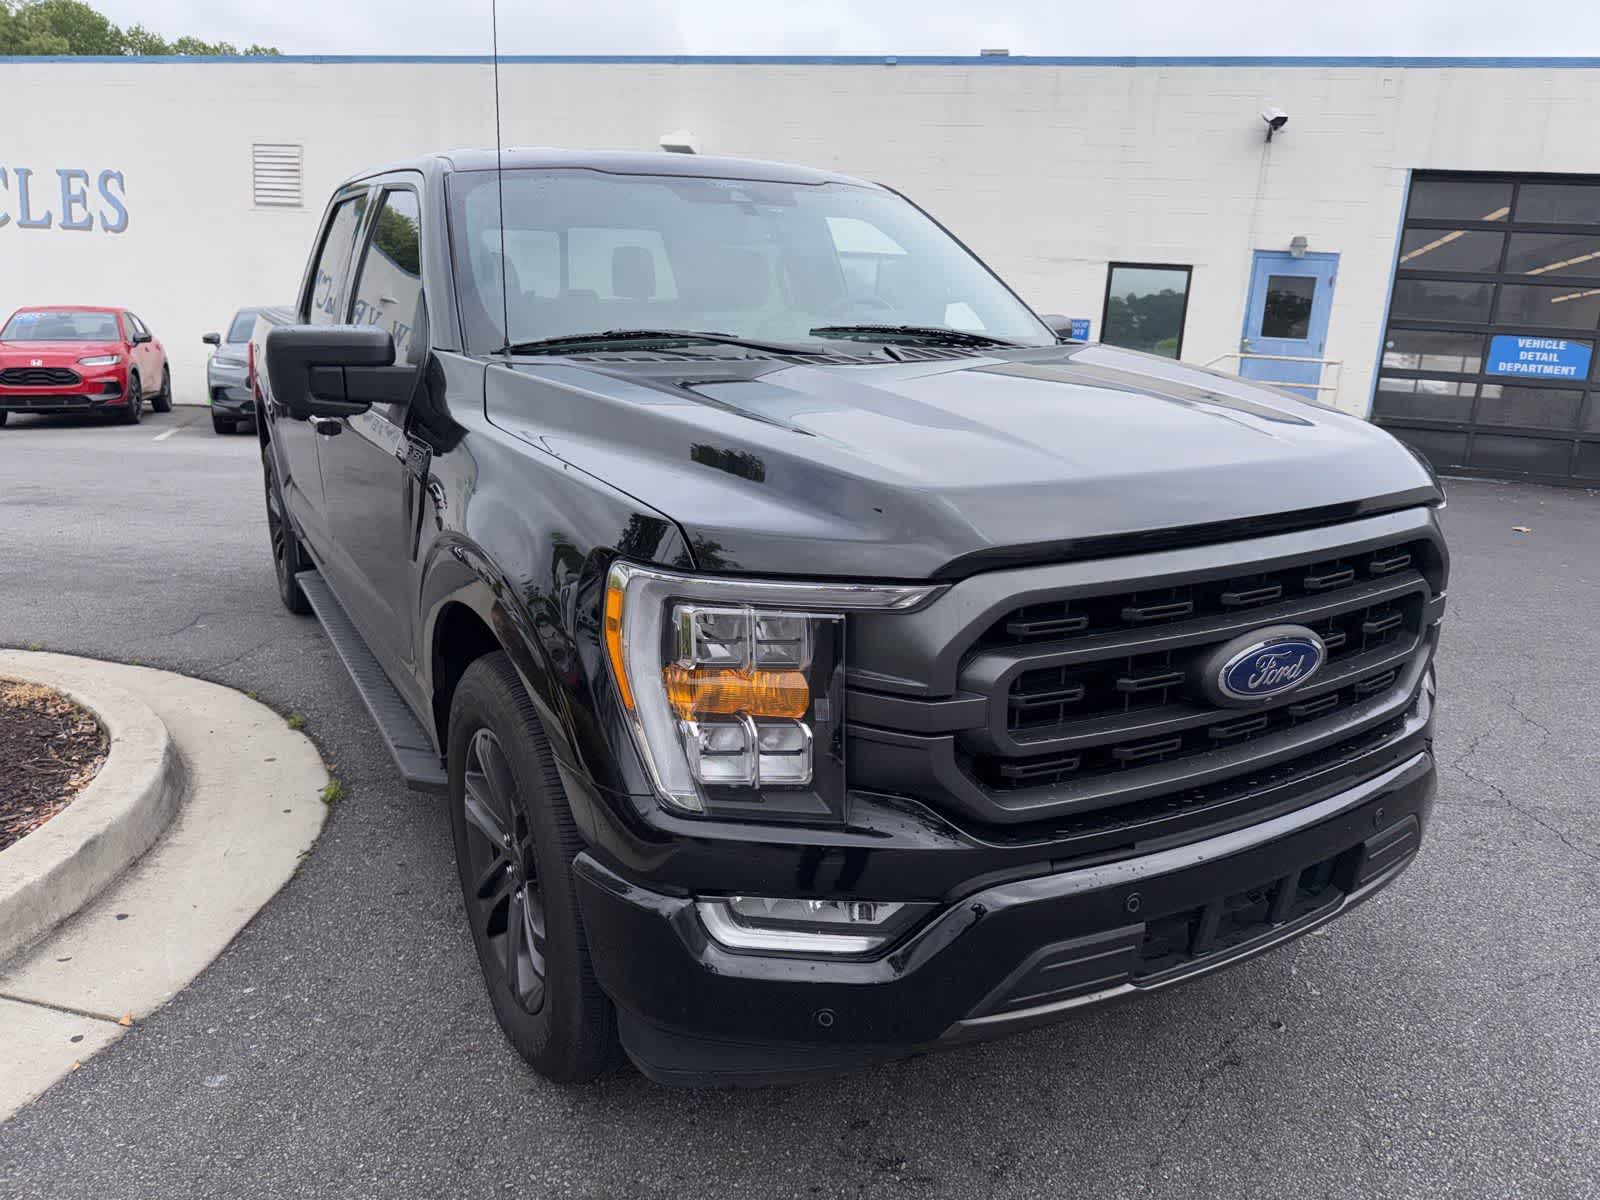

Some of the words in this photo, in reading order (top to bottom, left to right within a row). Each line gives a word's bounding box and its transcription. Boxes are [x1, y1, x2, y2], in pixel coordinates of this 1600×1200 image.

[1518, 339, 1567, 350] VEHICLE
[1519, 351, 1560, 362] DETAIL
[1498, 362, 1576, 375] DEPARTMENT
[1248, 651, 1304, 688] Ford
